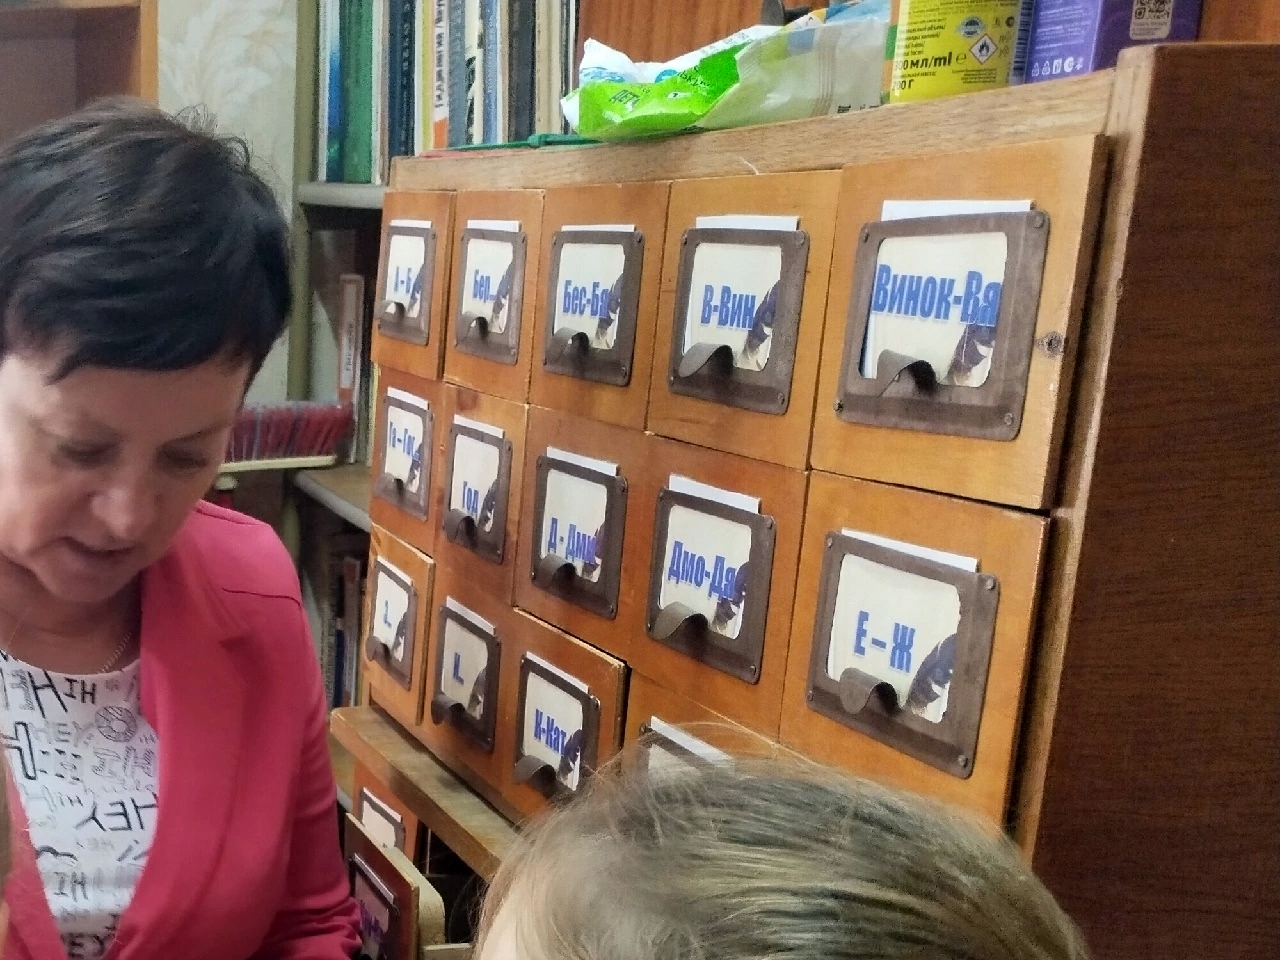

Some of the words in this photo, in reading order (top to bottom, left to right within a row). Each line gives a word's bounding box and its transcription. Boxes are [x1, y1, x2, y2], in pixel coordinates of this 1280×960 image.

[562, 279, 609, 318] Бес-Бя
[700, 284, 757, 330] В-Вин
[872, 263, 1004, 328] Винок-Вя
[668, 540, 737, 600] Дмо-Дя
